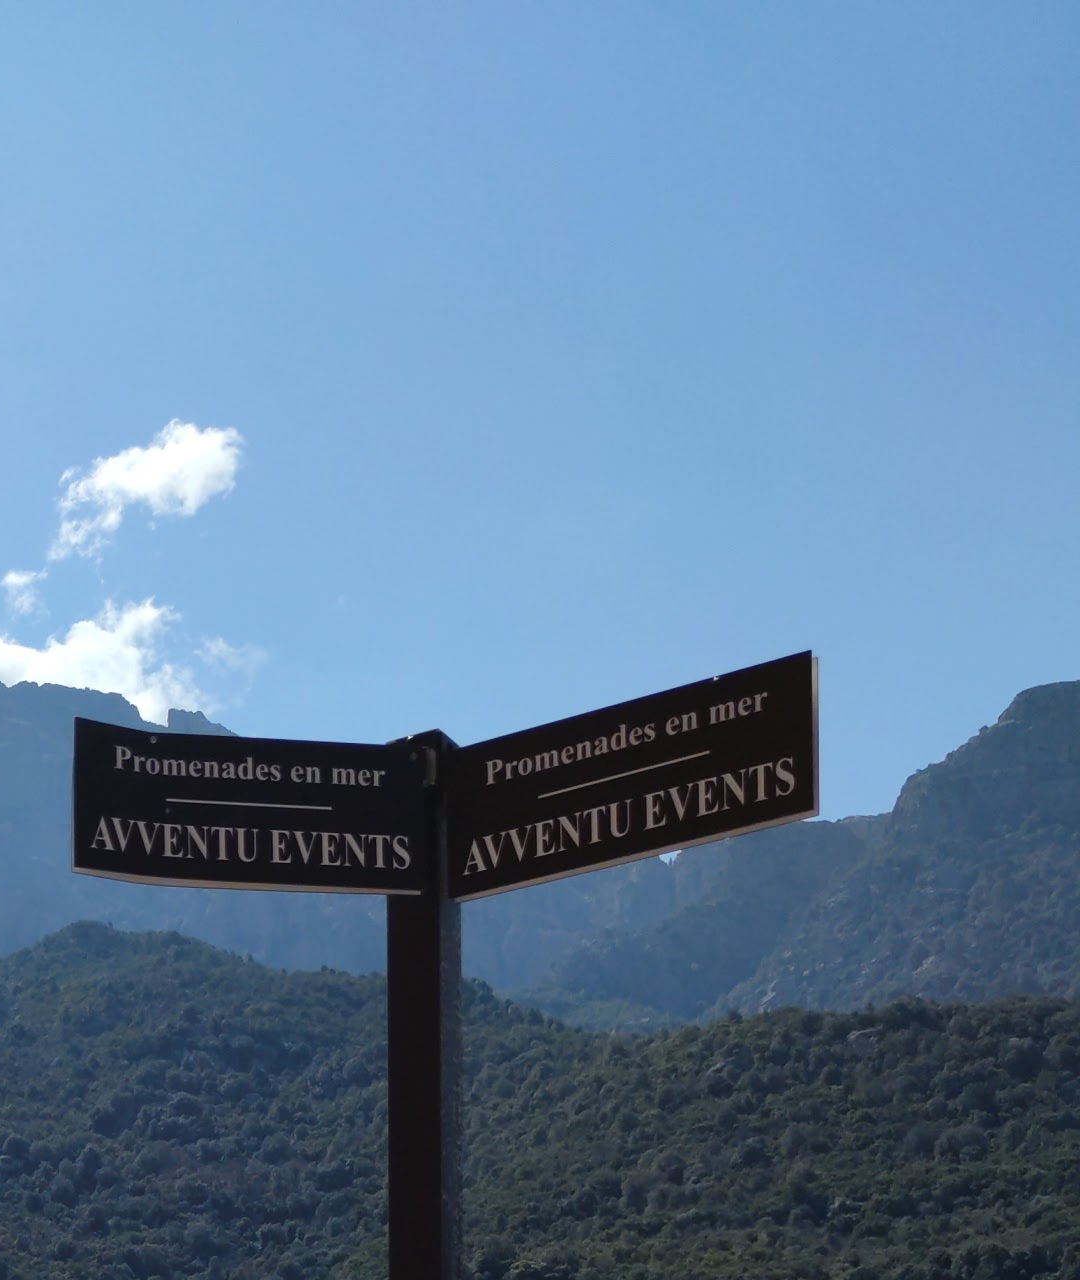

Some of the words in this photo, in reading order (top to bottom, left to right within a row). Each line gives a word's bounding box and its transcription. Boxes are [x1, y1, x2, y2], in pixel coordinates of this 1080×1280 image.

[114, 745, 281, 783] Promenades
[290, 762, 321, 784] en
[331, 767, 386, 787] mer
[485, 722, 657, 786] Promenades
[665, 710, 698, 736] en
[709, 691, 768, 726] mer
[91, 816, 258, 862] AVVENTU
[270, 830, 411, 870] EVENTS
[463, 799, 633, 876] AVVENTU
[643, 756, 796, 831] EVENTS
